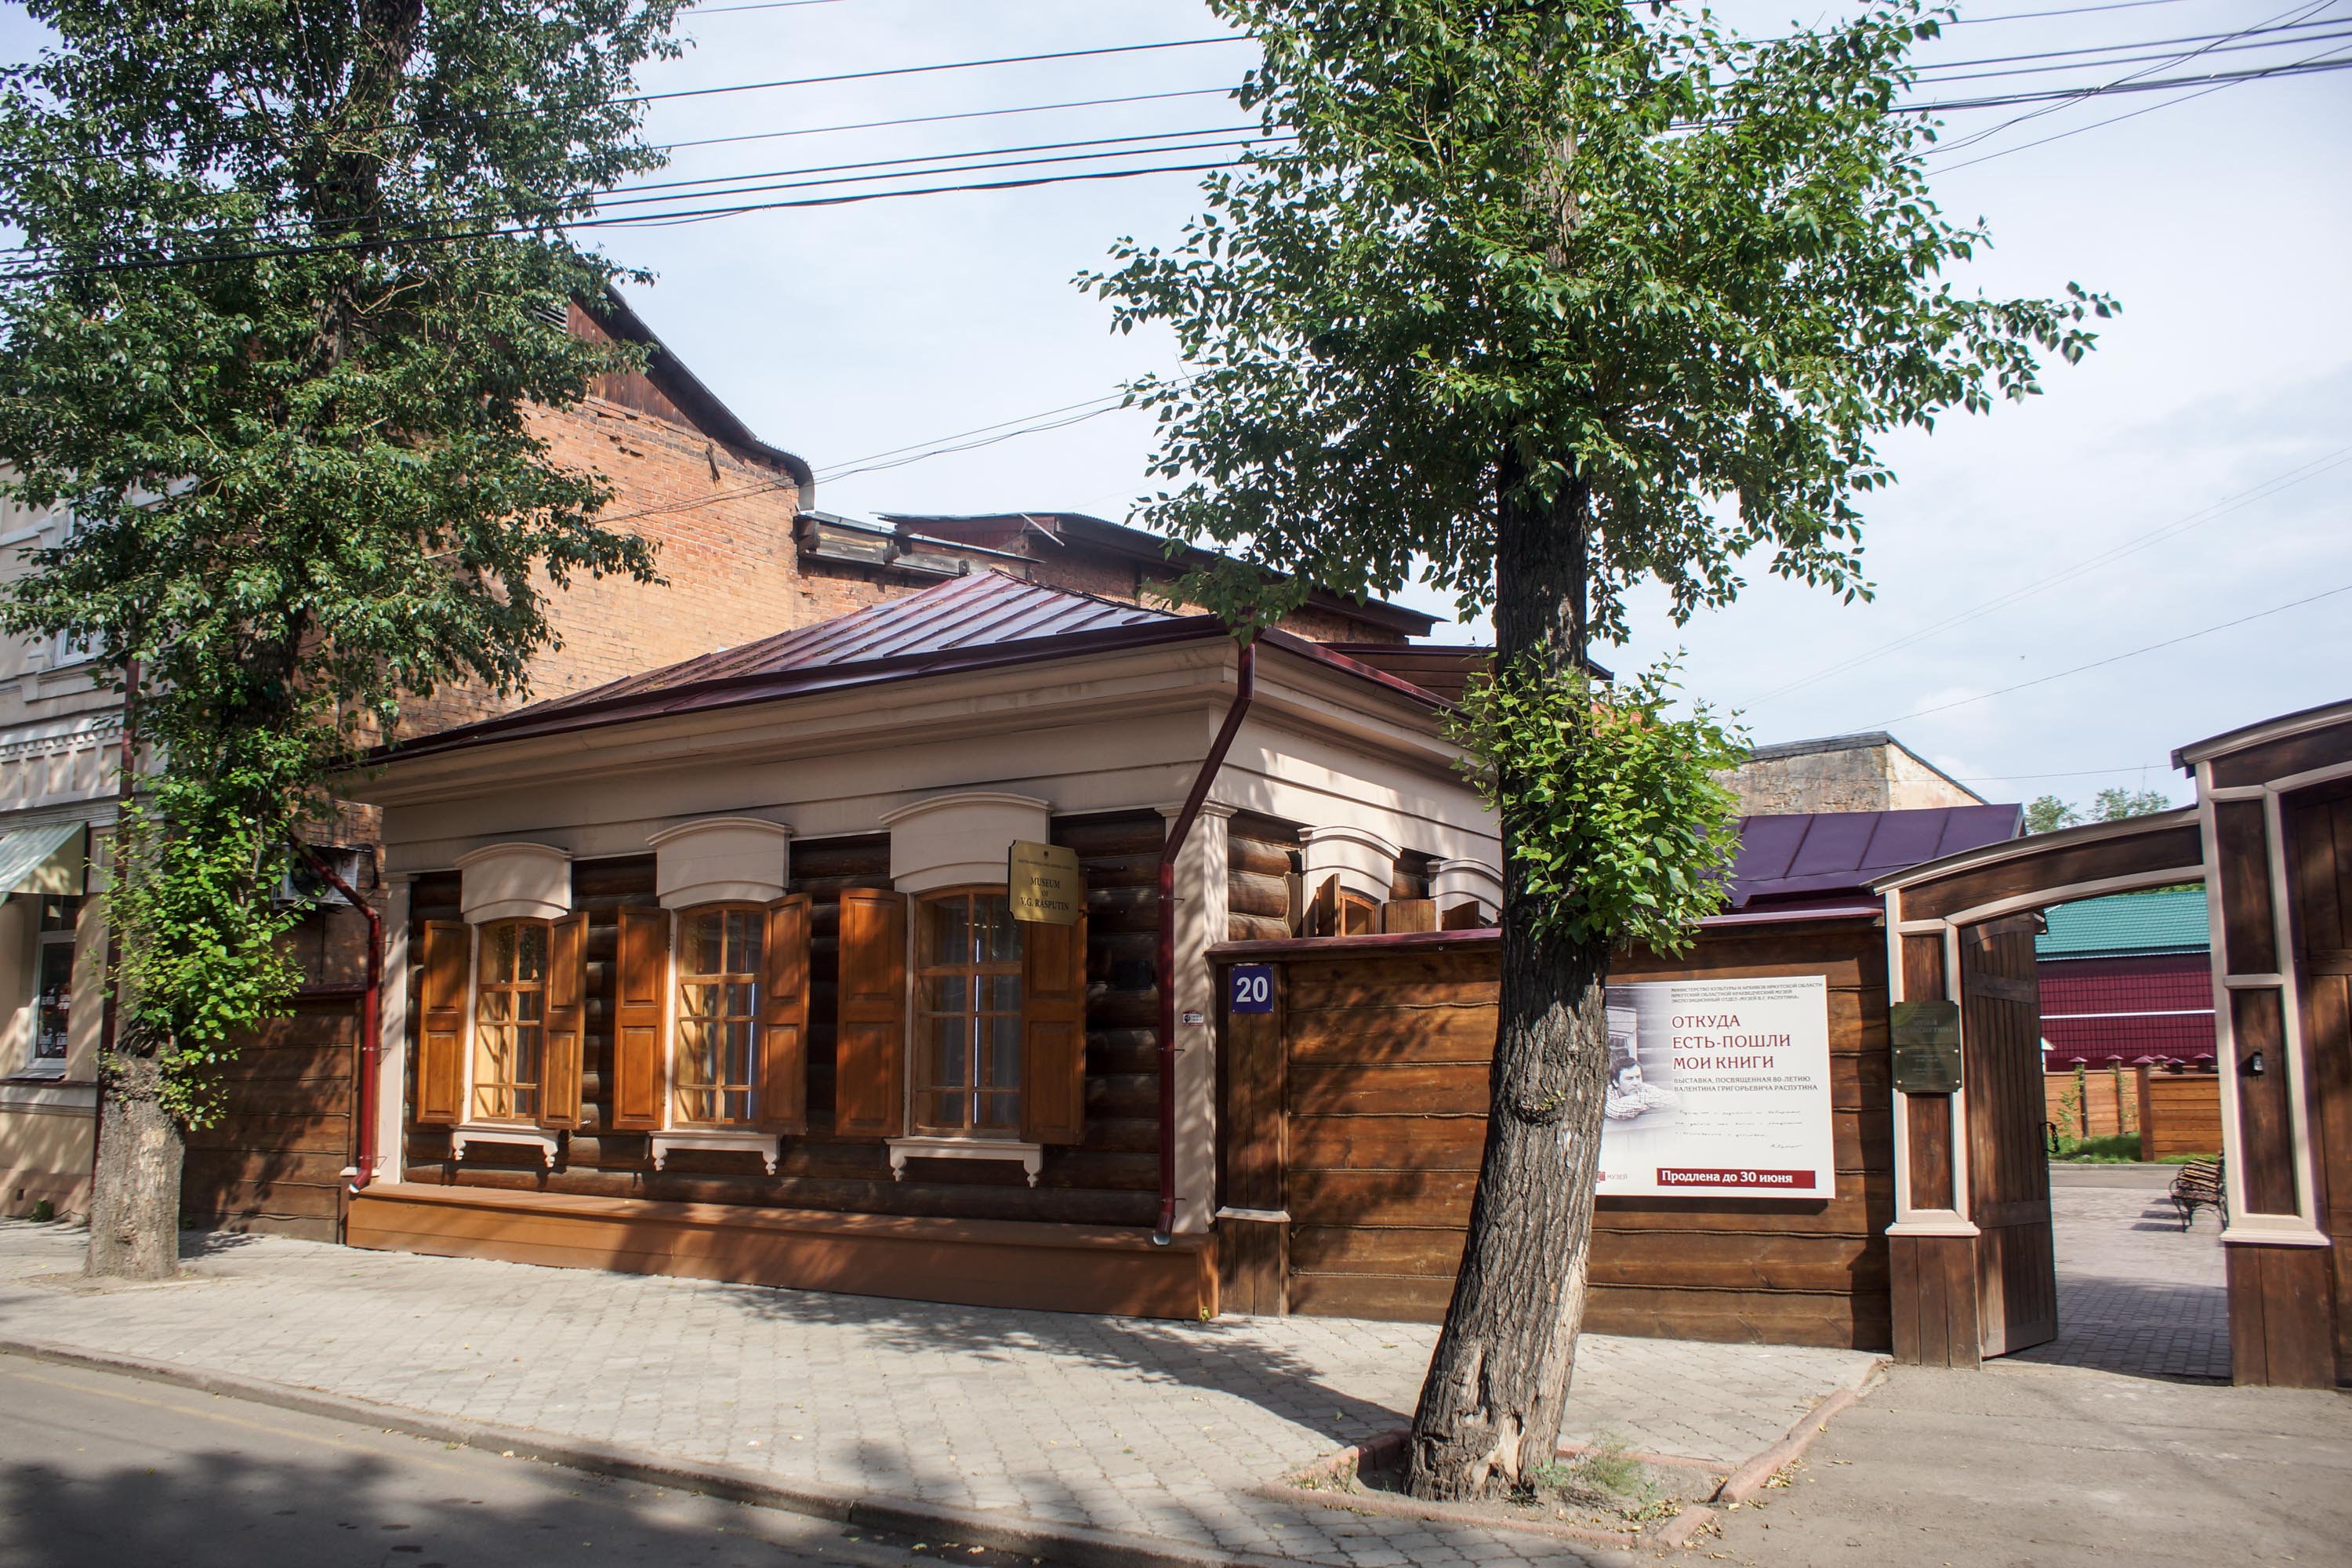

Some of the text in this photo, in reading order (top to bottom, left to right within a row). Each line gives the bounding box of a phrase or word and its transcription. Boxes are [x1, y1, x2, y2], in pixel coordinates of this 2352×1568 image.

[1030, 877, 1060, 888] MUSEUM
[1020, 897, 1069, 910] V.G. RASPUTIN
[1236, 977, 1268, 1003] 20
[1671, 1014, 1740, 1029] ОТКУДА
[1672, 1034, 1791, 1049] ЕСТЬ-ПОШЛИ
[1673, 1055, 1774, 1069] МОИ КНИГИ
[1661, 1171, 1793, 1183] Продлена до 30 июня
